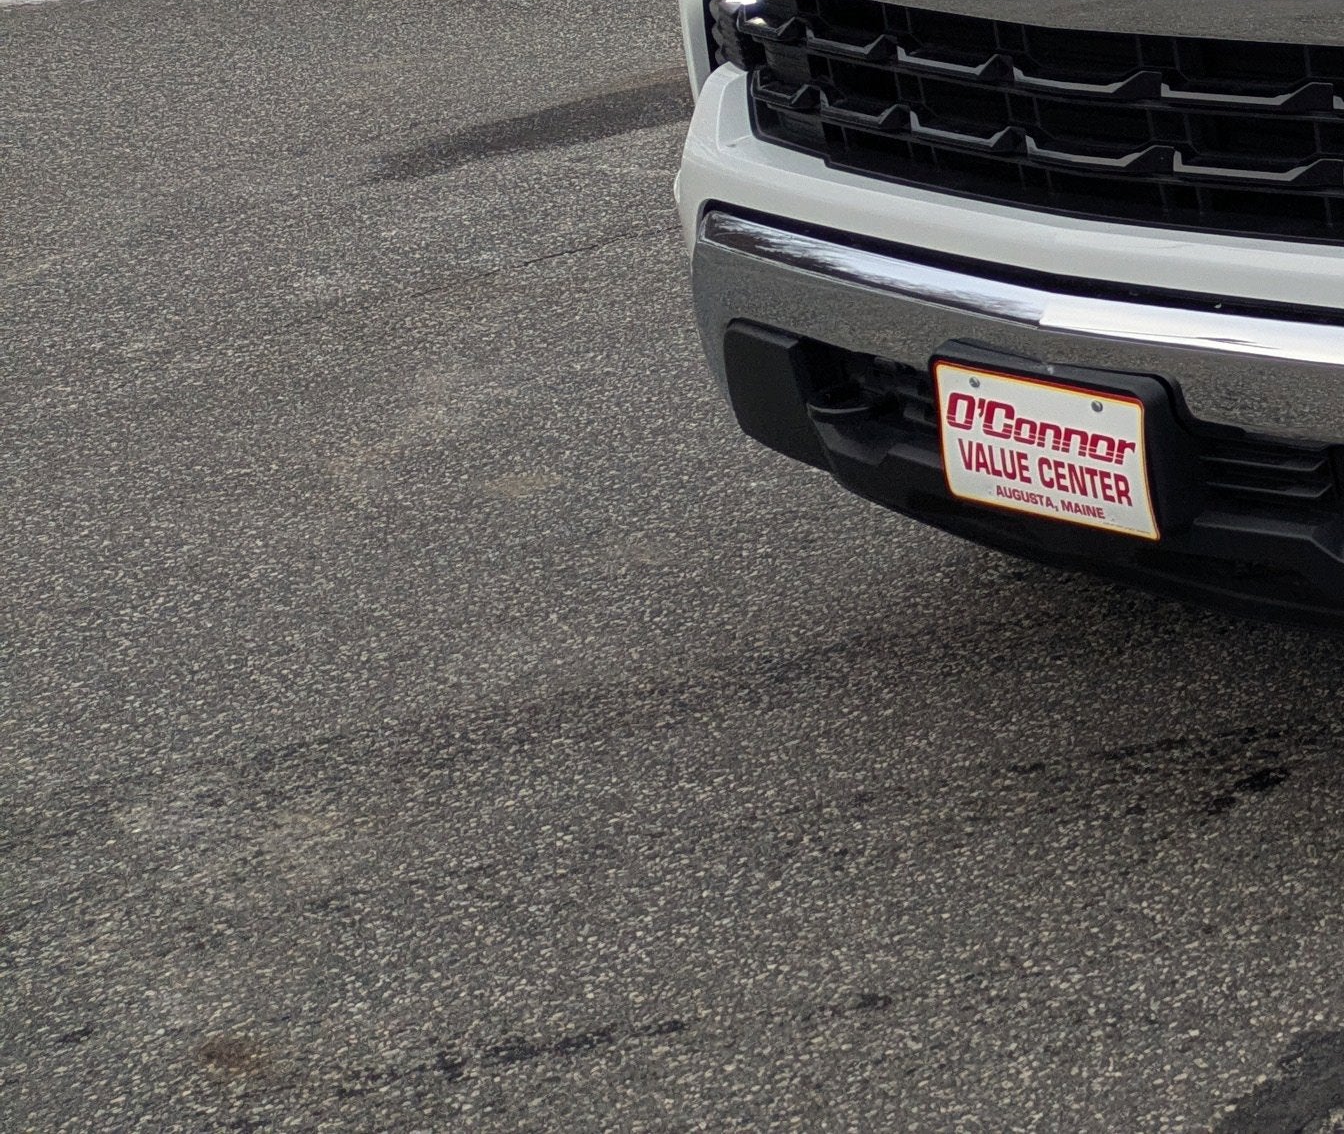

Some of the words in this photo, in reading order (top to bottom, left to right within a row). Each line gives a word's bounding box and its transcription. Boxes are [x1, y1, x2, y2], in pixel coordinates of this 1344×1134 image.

[946, 392, 1136, 466] O'Connor
[957, 438, 1032, 484] VALUE
[1037, 456, 1133, 507] CENTER
[996, 484, 1060, 512] AUGUSTA,
[1061, 499, 1106, 520] MAINE
